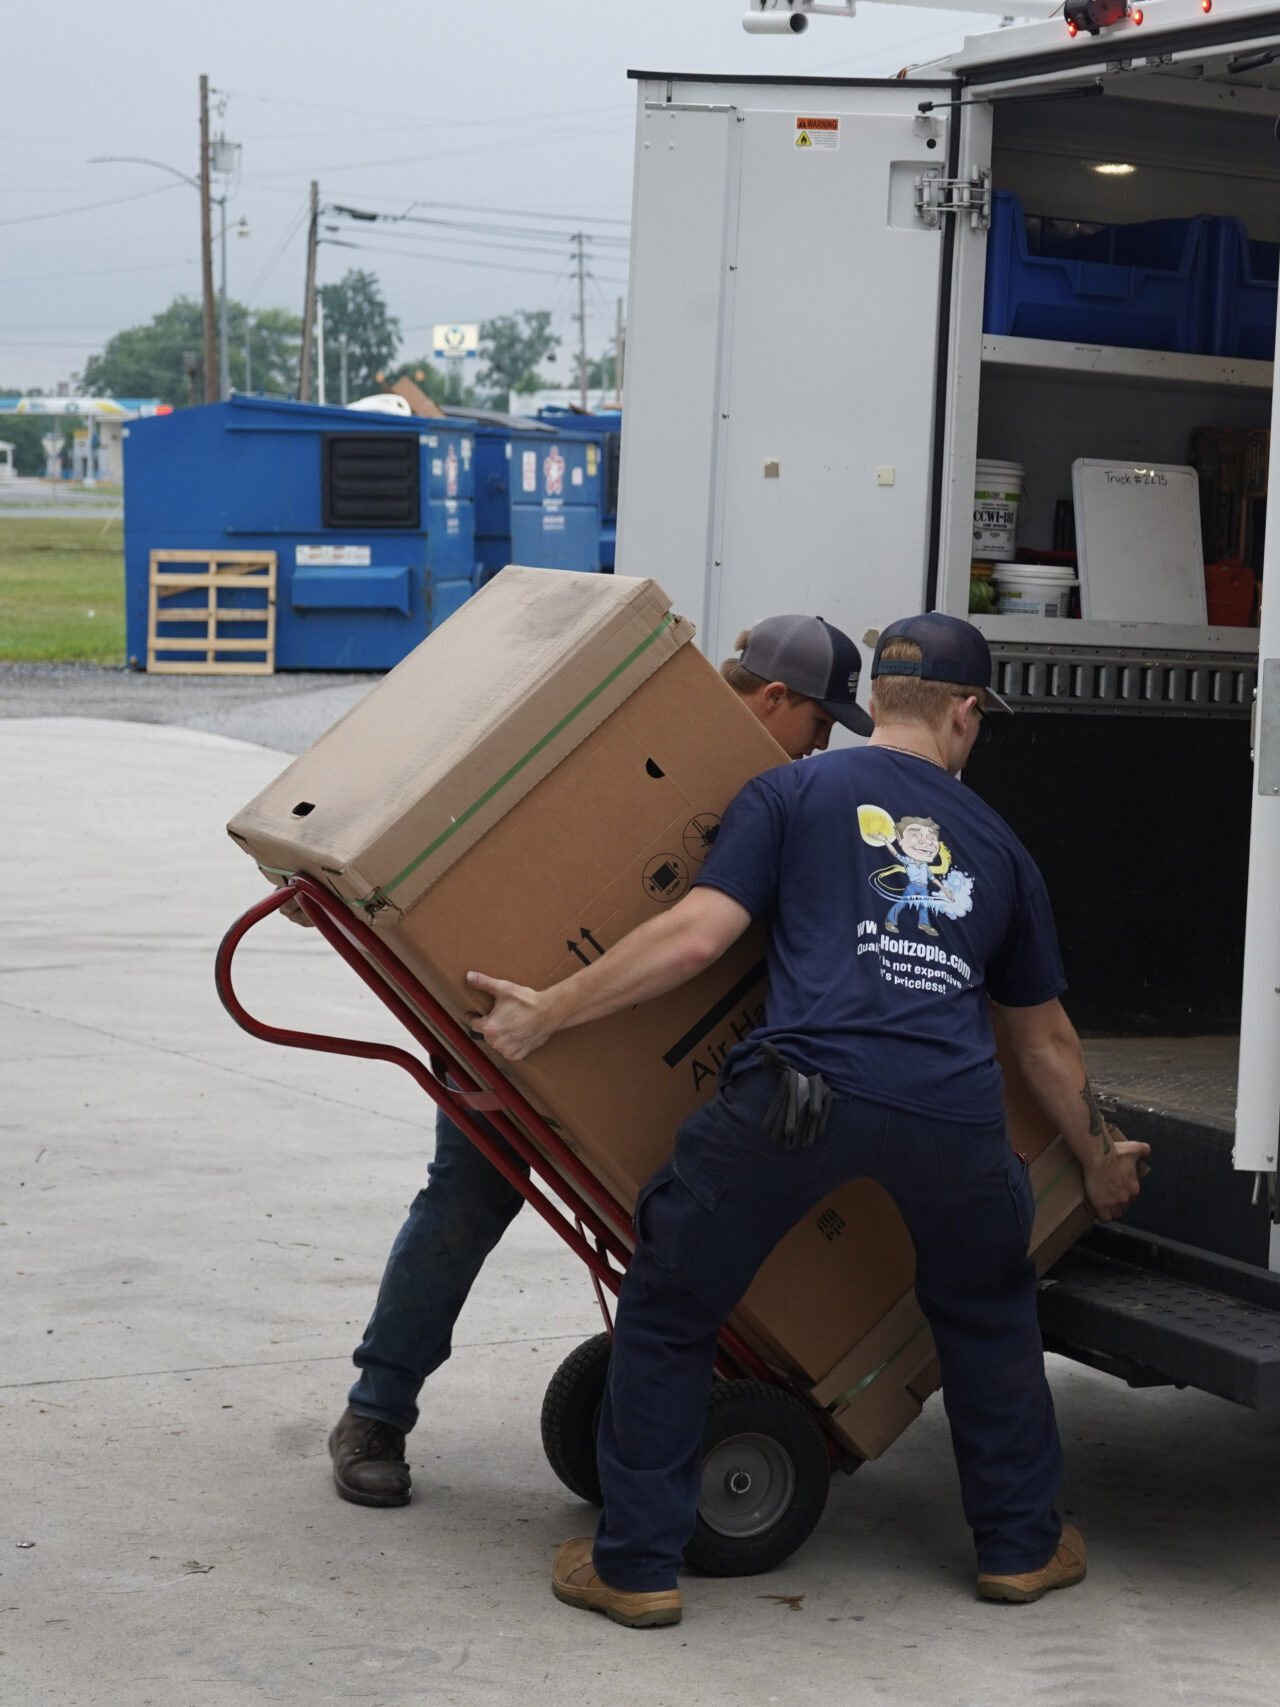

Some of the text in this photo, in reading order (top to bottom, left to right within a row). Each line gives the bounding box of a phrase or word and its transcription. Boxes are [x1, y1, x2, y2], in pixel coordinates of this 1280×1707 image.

[807, 119, 838, 130] WARNING
[1104, 471, 1131, 485] Truck
[892, 962, 912, 973] not
[914, 965, 962, 989] expensive
[894, 975, 946, 995] priceless!
[691, 1040, 728, 1093] Air
